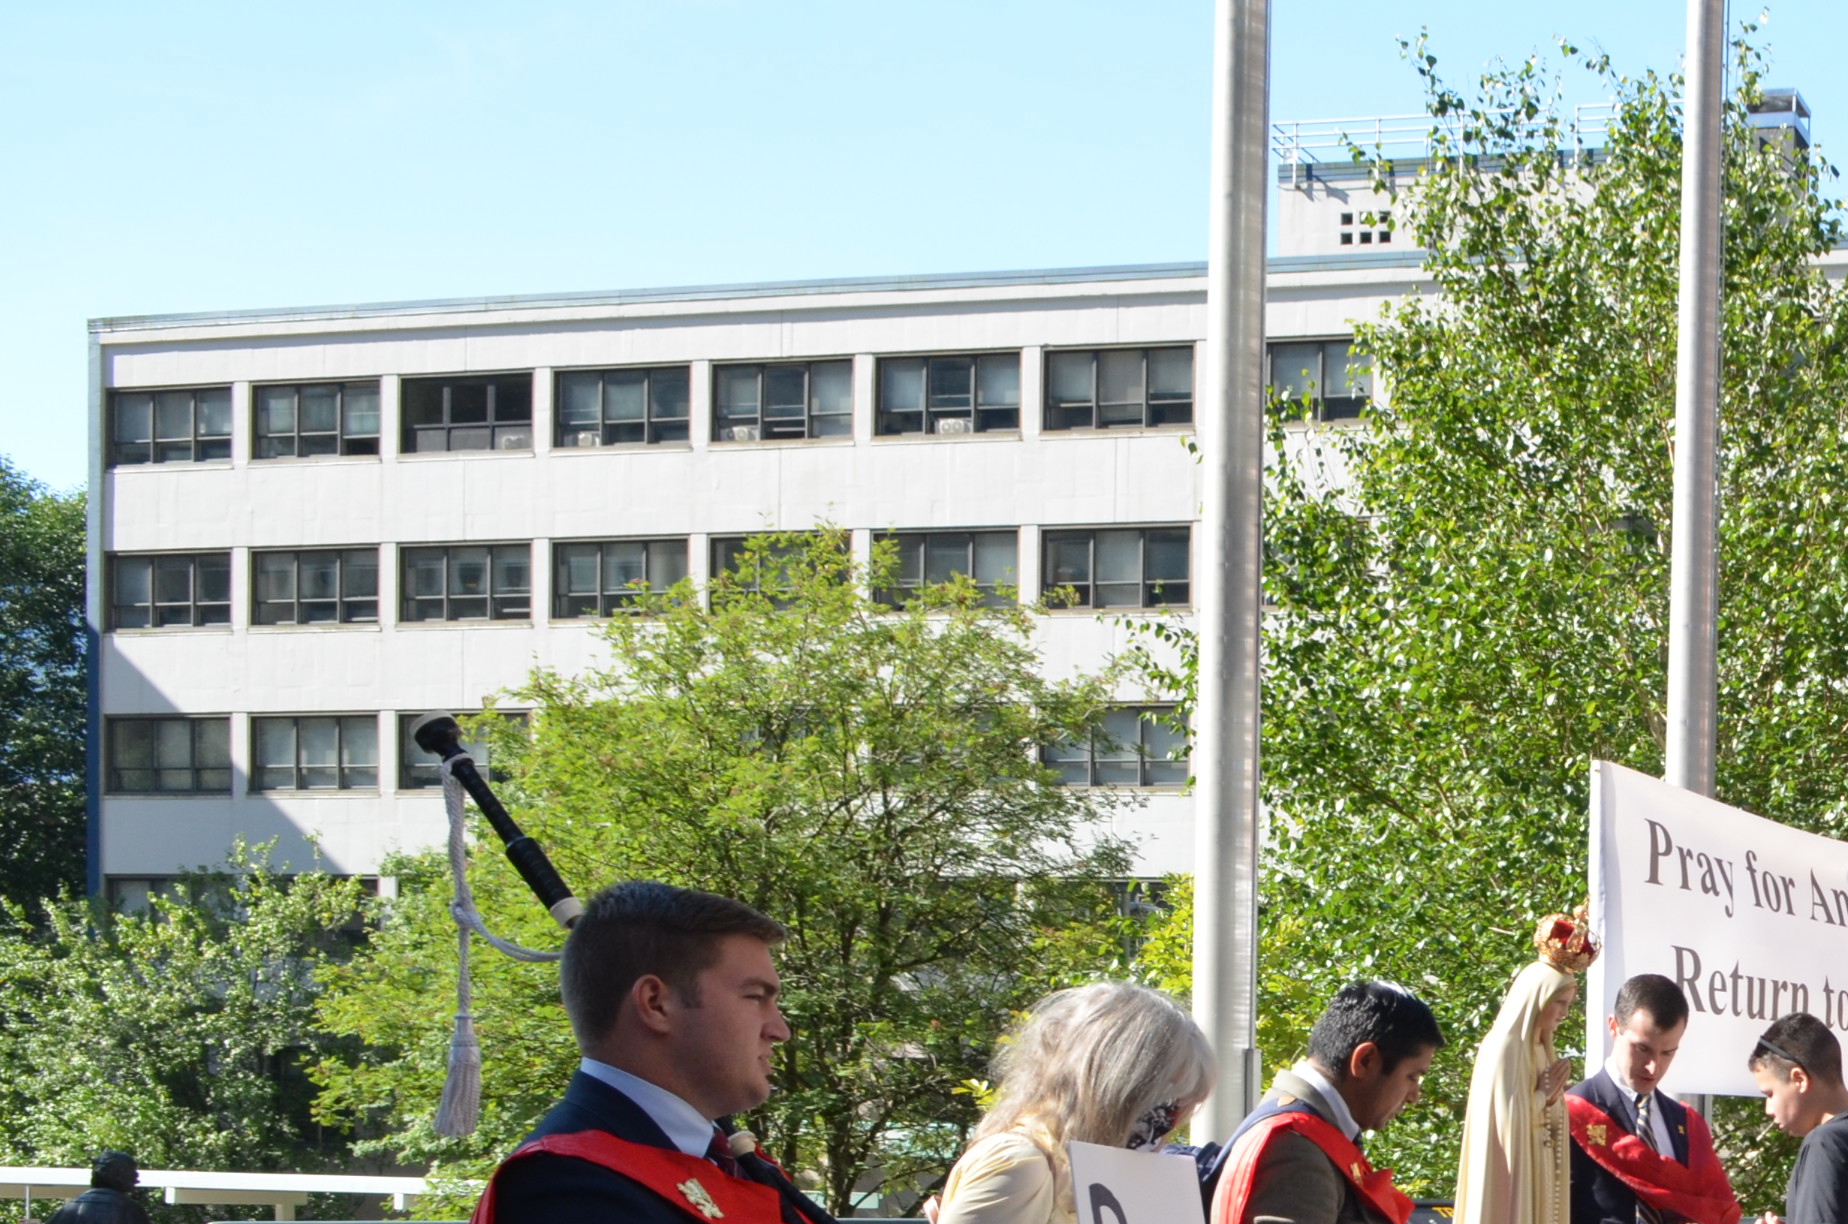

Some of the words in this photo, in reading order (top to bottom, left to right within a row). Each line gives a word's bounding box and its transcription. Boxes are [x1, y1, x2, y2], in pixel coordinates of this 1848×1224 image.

[1645, 818, 1734, 918] Pray
[1745, 849, 1796, 916] for
[1672, 945, 1809, 1021] Return
